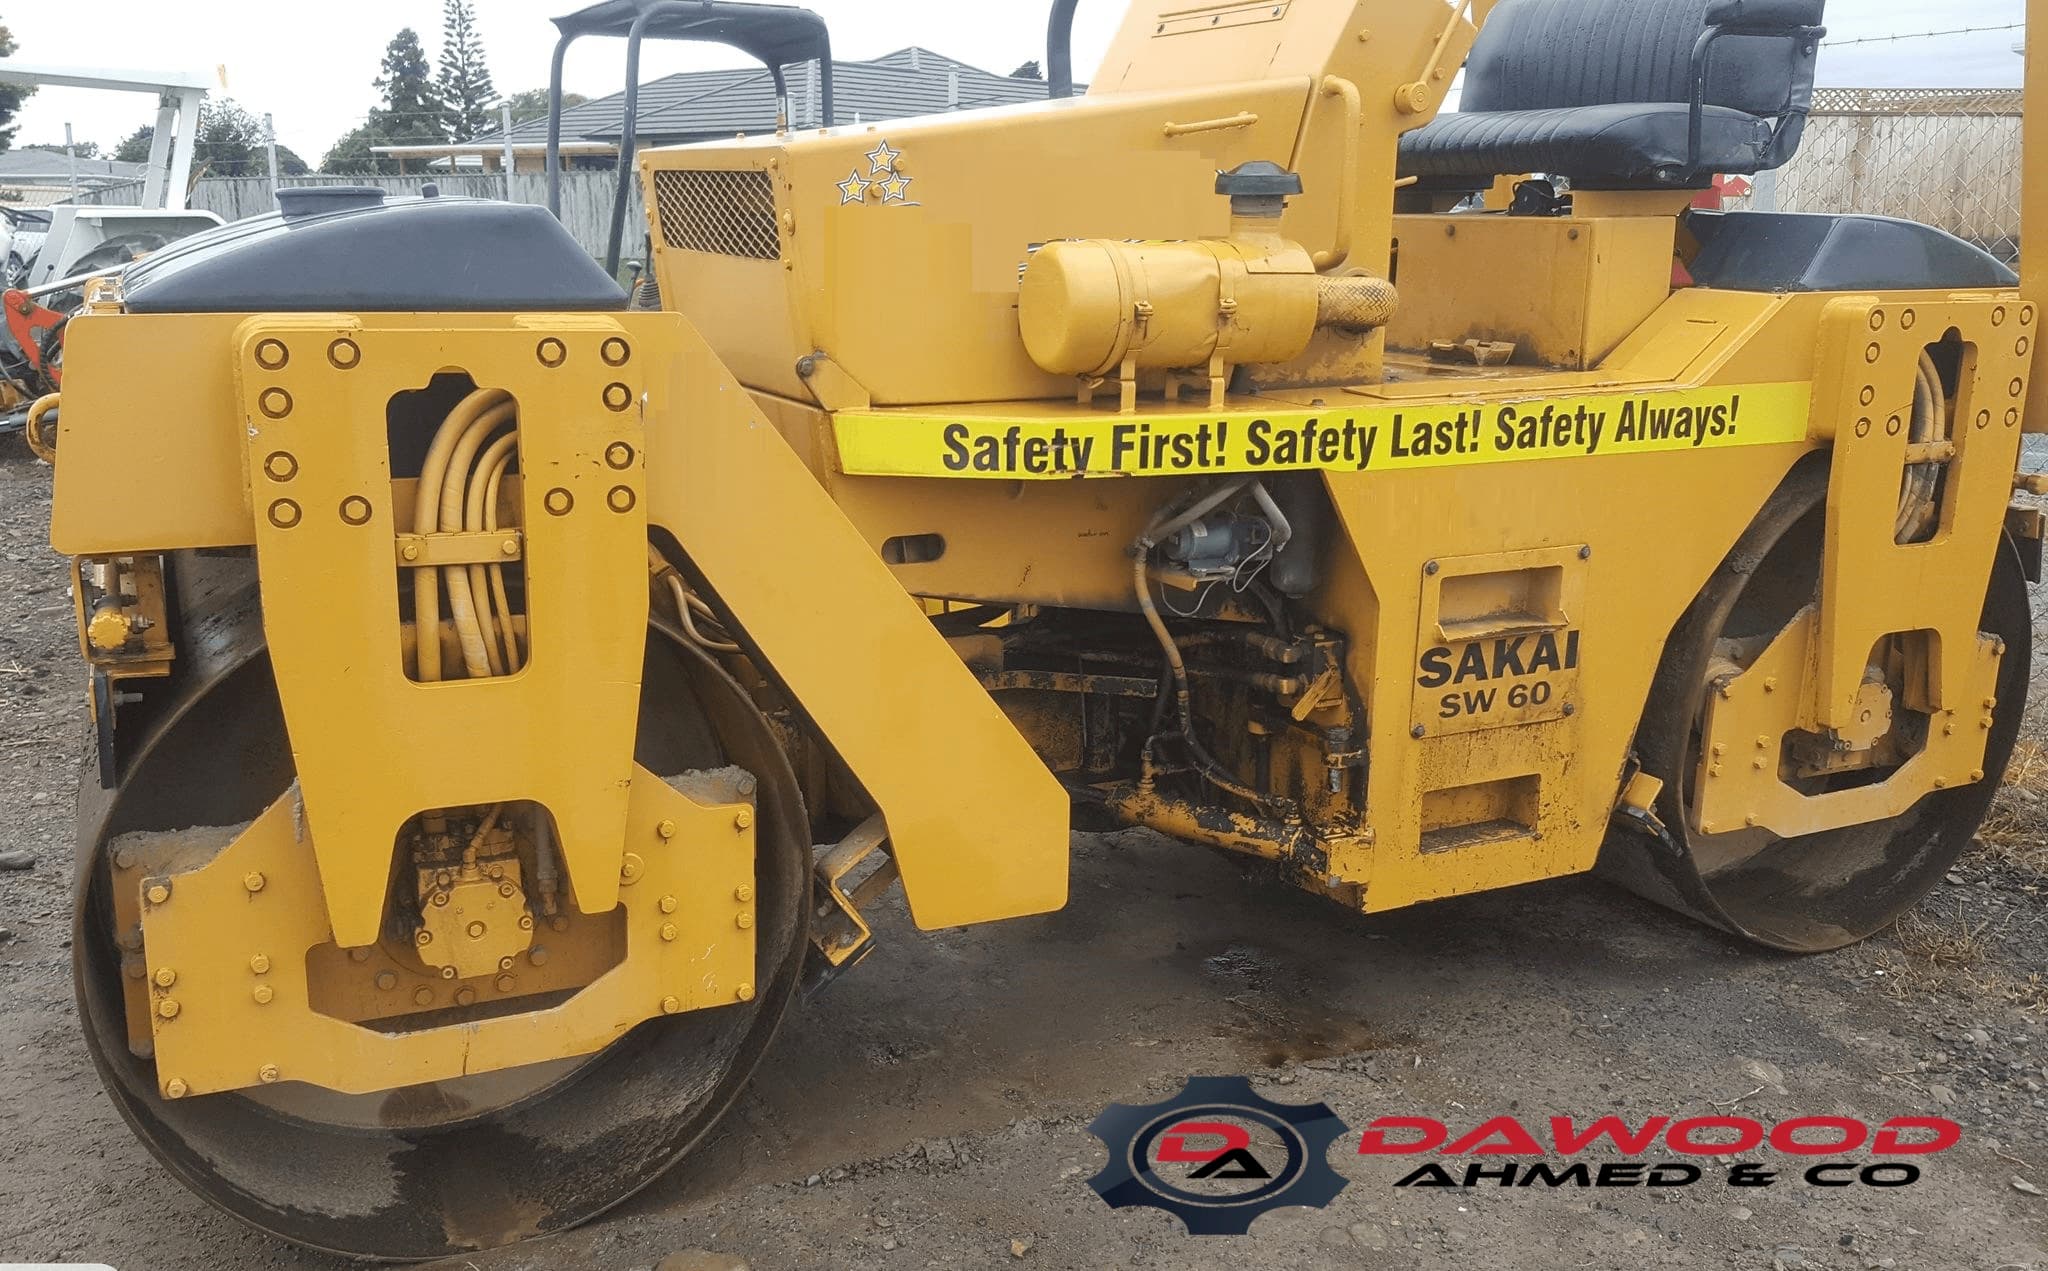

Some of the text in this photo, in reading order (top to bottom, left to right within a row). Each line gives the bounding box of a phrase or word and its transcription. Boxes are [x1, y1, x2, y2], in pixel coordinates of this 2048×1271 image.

[942, 394, 1740, 474] Safety First! Safety Last! Safety Always!
[1417, 630, 1580, 689] SAKAI
[1438, 681, 1551, 719] SW 60
